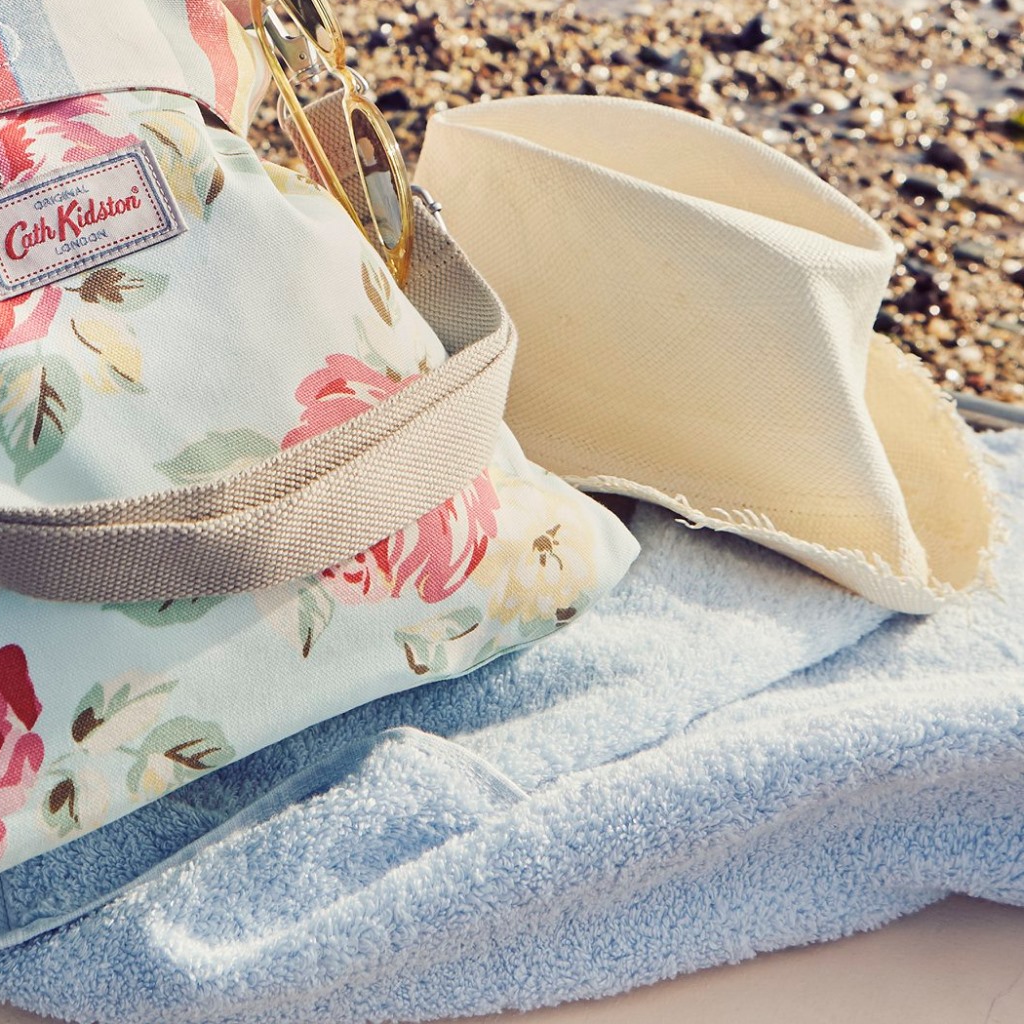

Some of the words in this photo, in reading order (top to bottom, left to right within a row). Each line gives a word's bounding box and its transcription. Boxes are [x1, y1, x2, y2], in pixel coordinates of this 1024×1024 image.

[33, 184, 89, 211] ORIGINAL
[5, 216, 57, 260] Cath
[54, 228, 110, 256] LONDON
